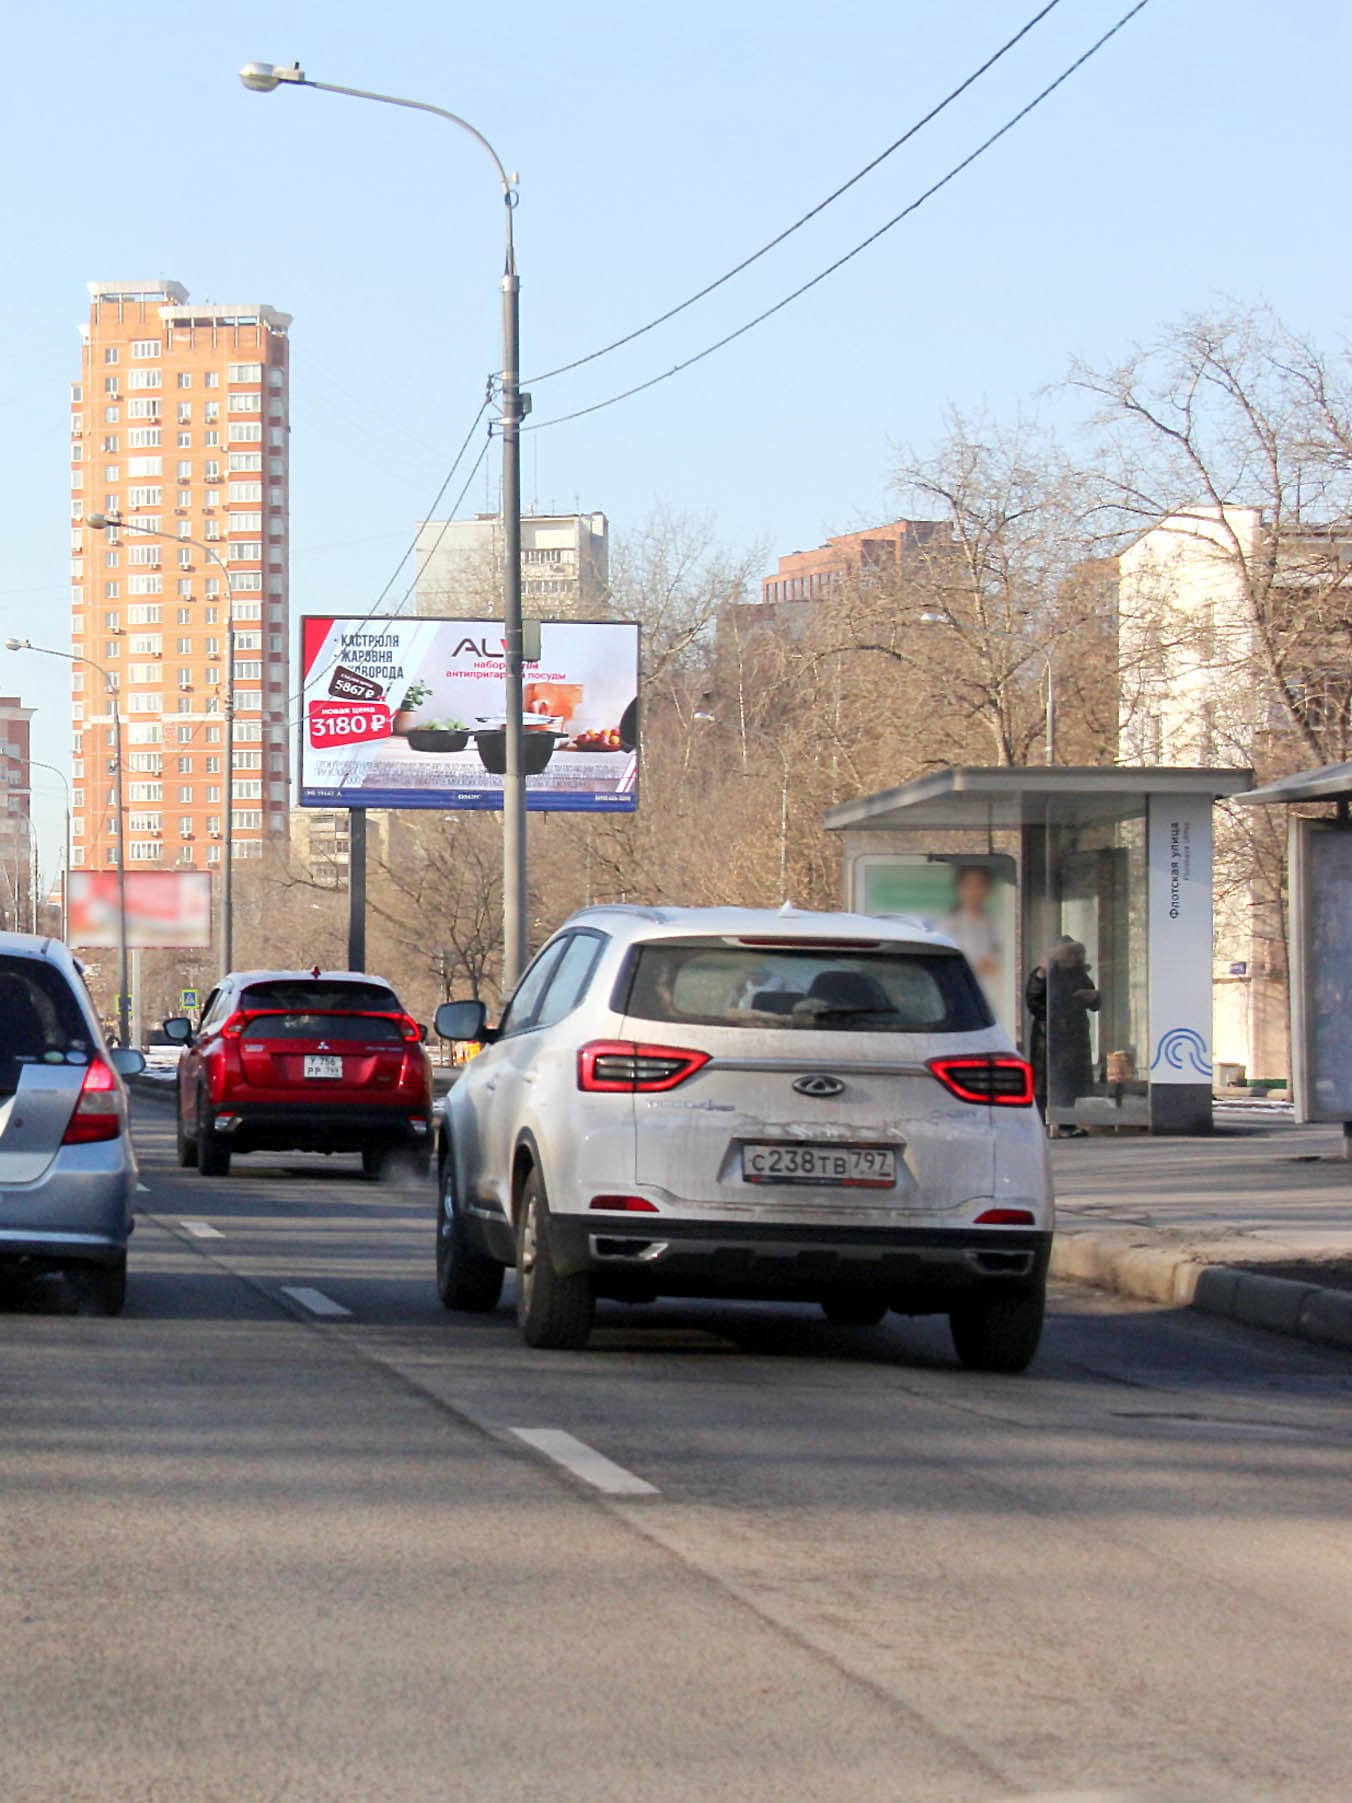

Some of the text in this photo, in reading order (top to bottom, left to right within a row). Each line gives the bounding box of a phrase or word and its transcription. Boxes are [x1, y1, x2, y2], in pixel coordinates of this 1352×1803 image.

[341, 634, 399, 647] КАСТРЮЛЯ
[341, 650, 393, 662] ЖАРОВНЯ
[528, 672, 566, 681] посуды
[334, 680, 364, 696] 5867
[321, 706, 376, 715] новая цена
[311, 715, 367, 736] 3180
[1169, 822, 1182, 919] Флотская улица
